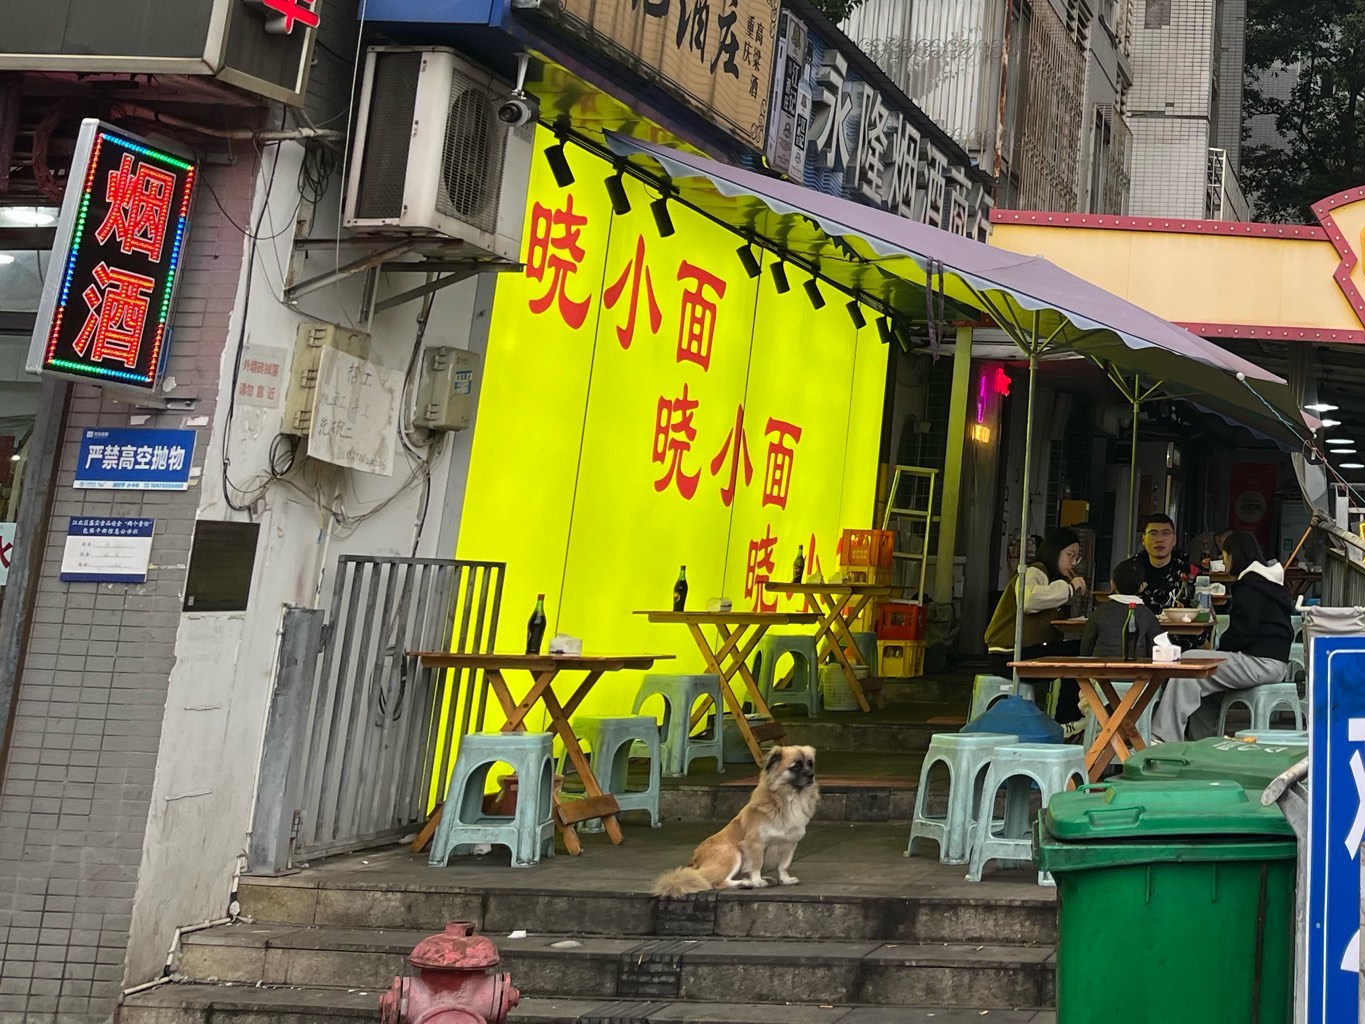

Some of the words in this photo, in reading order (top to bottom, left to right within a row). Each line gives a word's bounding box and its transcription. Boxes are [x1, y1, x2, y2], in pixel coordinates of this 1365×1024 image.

[742, 15, 756, 66] 重庆
[72, 152, 177, 369] 烟酒
[525, 193, 727, 373] 晓小面
[238, 382, 277, 401] 请勿靠近
[85, 444, 186, 471] 严禁高空抛物
[652, 382, 803, 511] 晓小面
